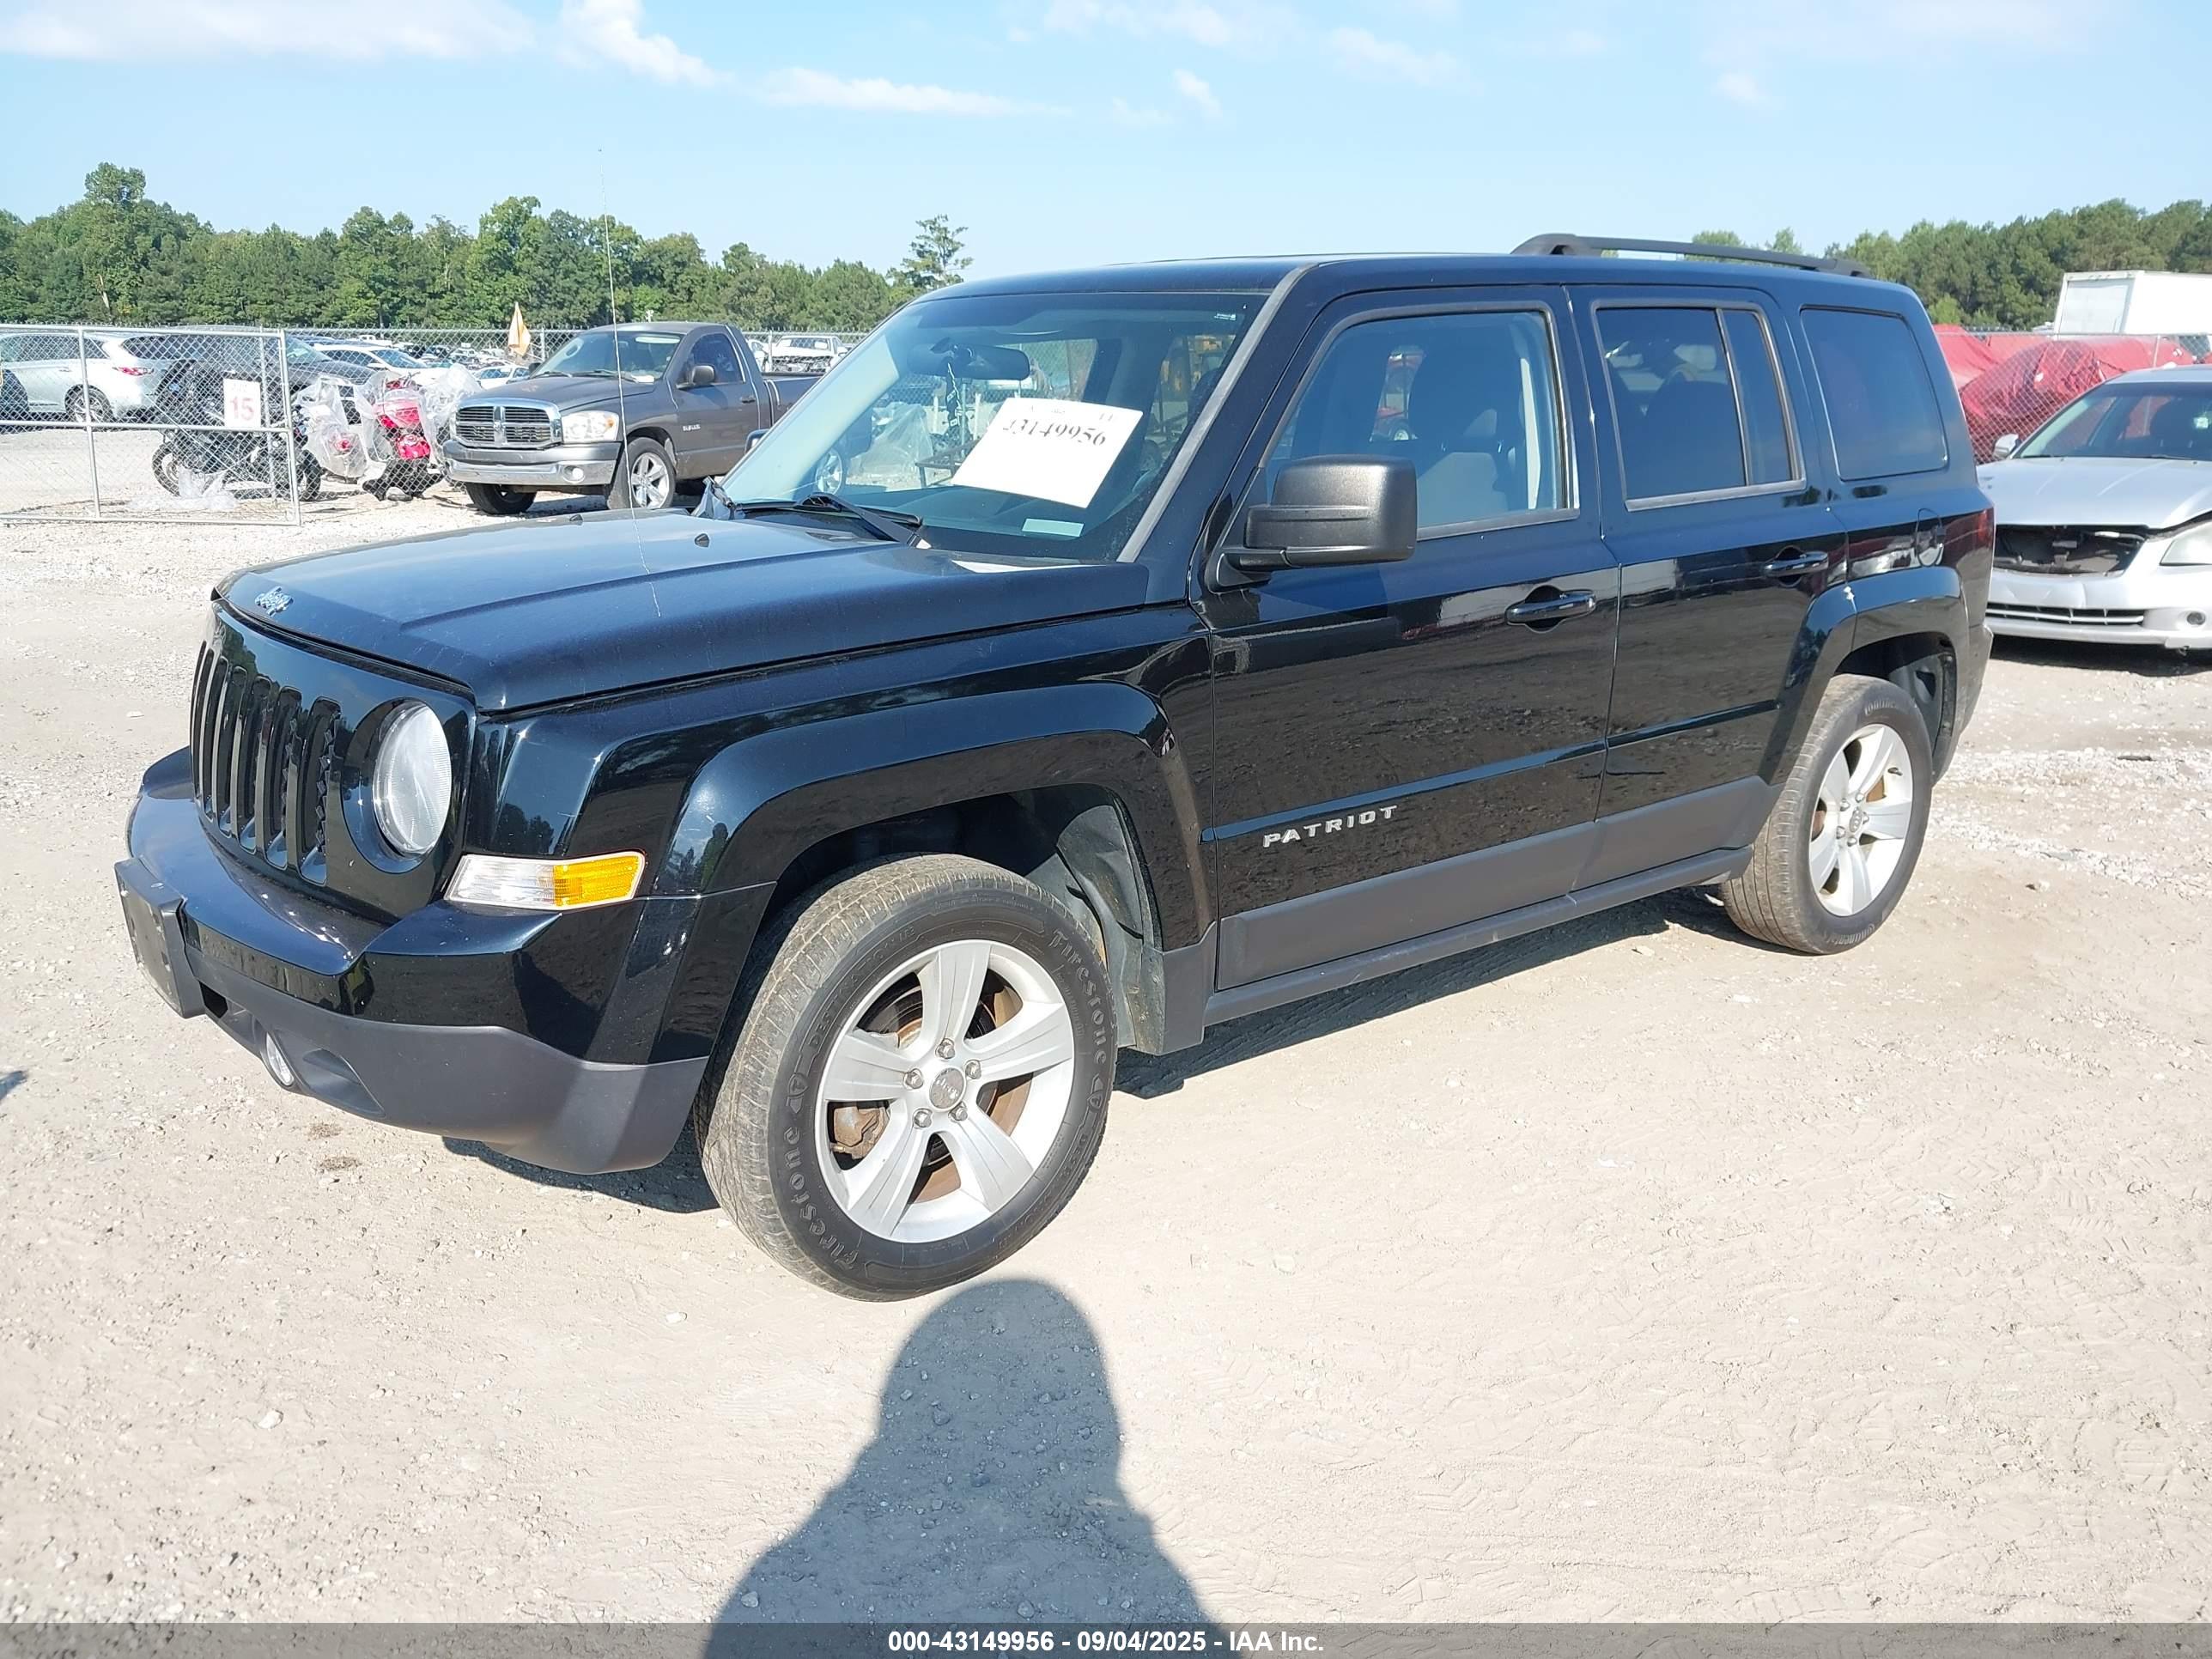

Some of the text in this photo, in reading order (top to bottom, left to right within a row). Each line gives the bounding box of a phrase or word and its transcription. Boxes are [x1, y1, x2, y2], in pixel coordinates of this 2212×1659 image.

[229, 396, 255, 422] 15
[1262, 805, 1398, 848] PATRIOT
[1048, 929, 1108, 1066] Firestone
[783, 1126, 860, 1271] Firestone
